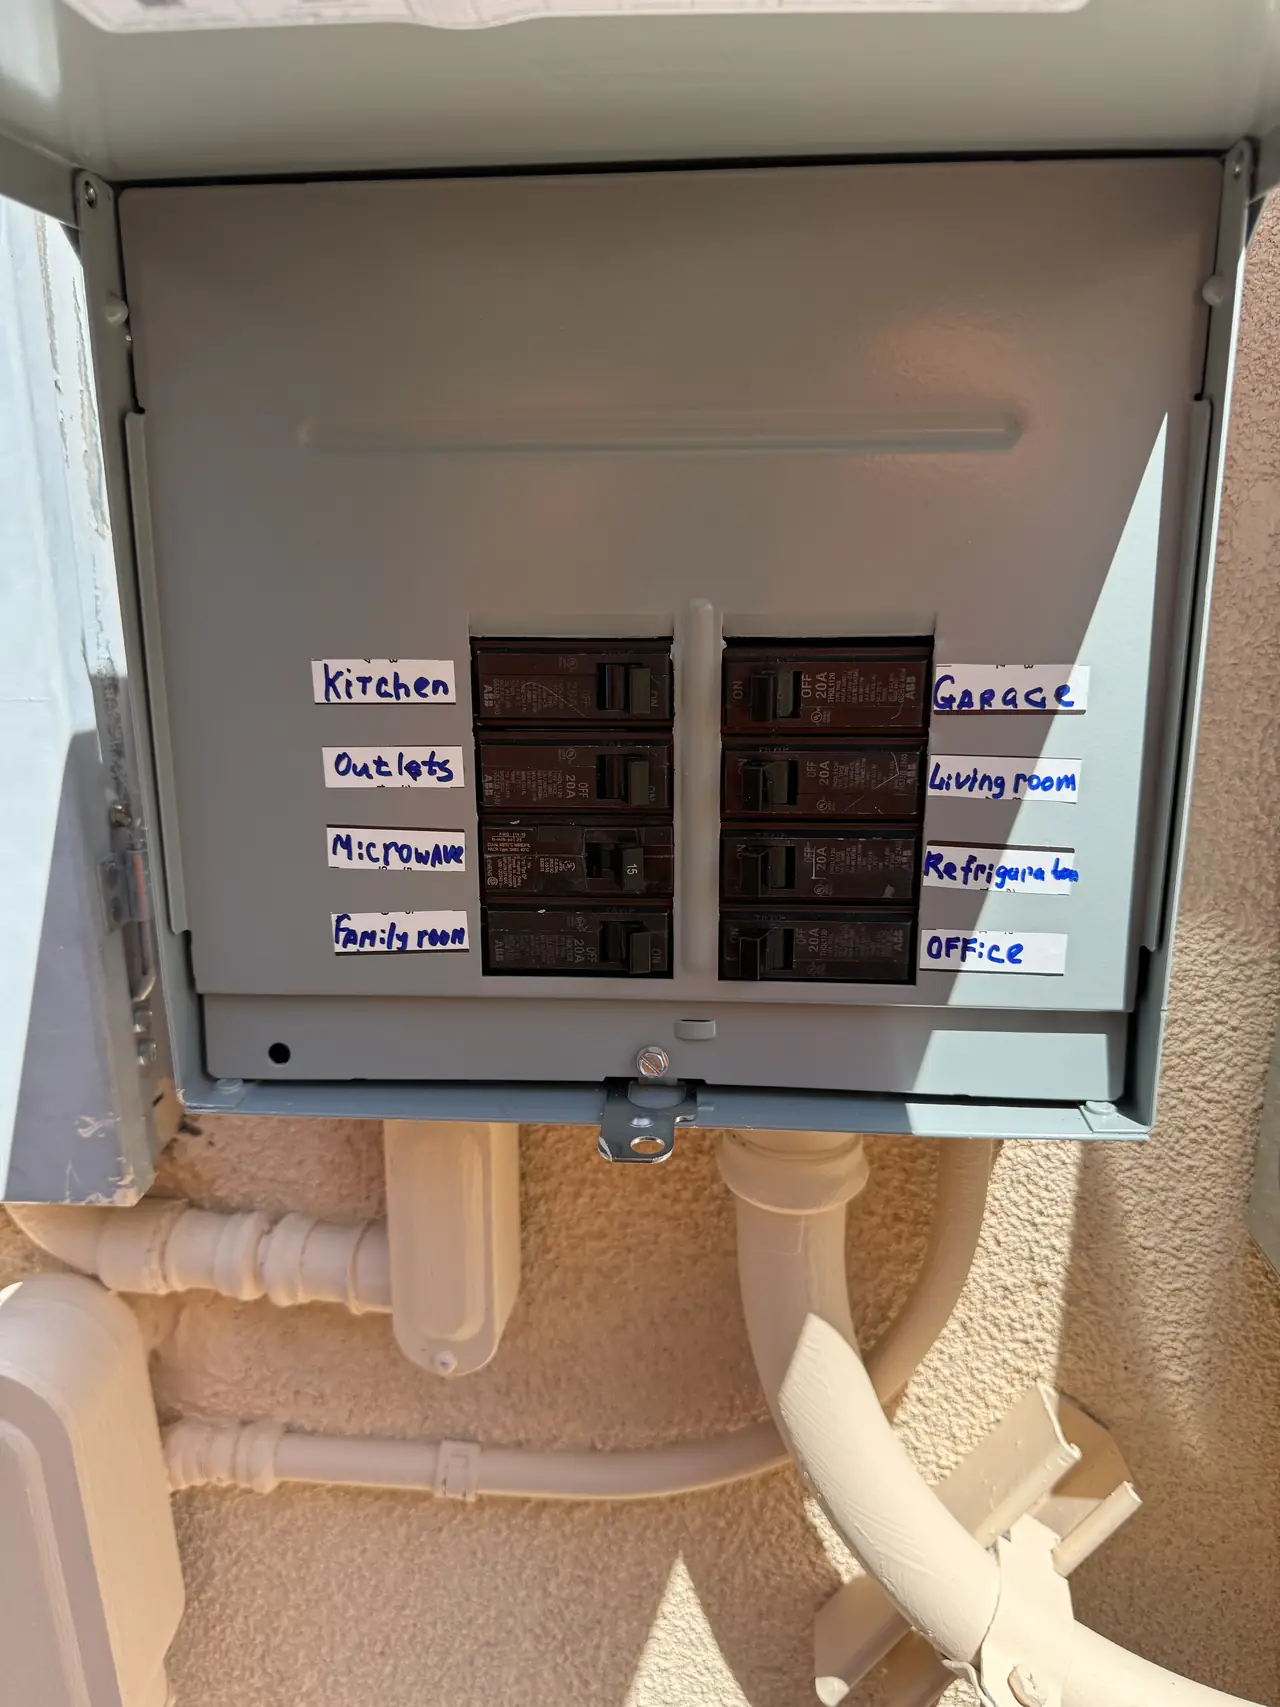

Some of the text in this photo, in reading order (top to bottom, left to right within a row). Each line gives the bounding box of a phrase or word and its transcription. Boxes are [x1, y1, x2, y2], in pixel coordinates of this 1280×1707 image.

[732, 680, 744, 699] ON
[801, 673, 813, 698] OFF
[815, 671, 828, 699] 20A
[905, 675, 916, 700] ABB
[334, 750, 454, 782] Outlets
[806, 760, 817, 778] OFF
[818, 760, 830, 786] 20A
[565, 774, 576, 799] 20A
[578, 782, 589, 800] OFF
[929, 762, 1005, 799] Living
[1013, 773, 1076, 794] room
[626, 863, 638, 876] 15
[816, 846, 827, 871] 20A
[416, 927, 466, 949] room
[808, 927, 820, 953] 20A
[574, 938, 585, 964] 20A
[586, 946, 598, 964] OFF
[652, 948, 662, 964] ON
